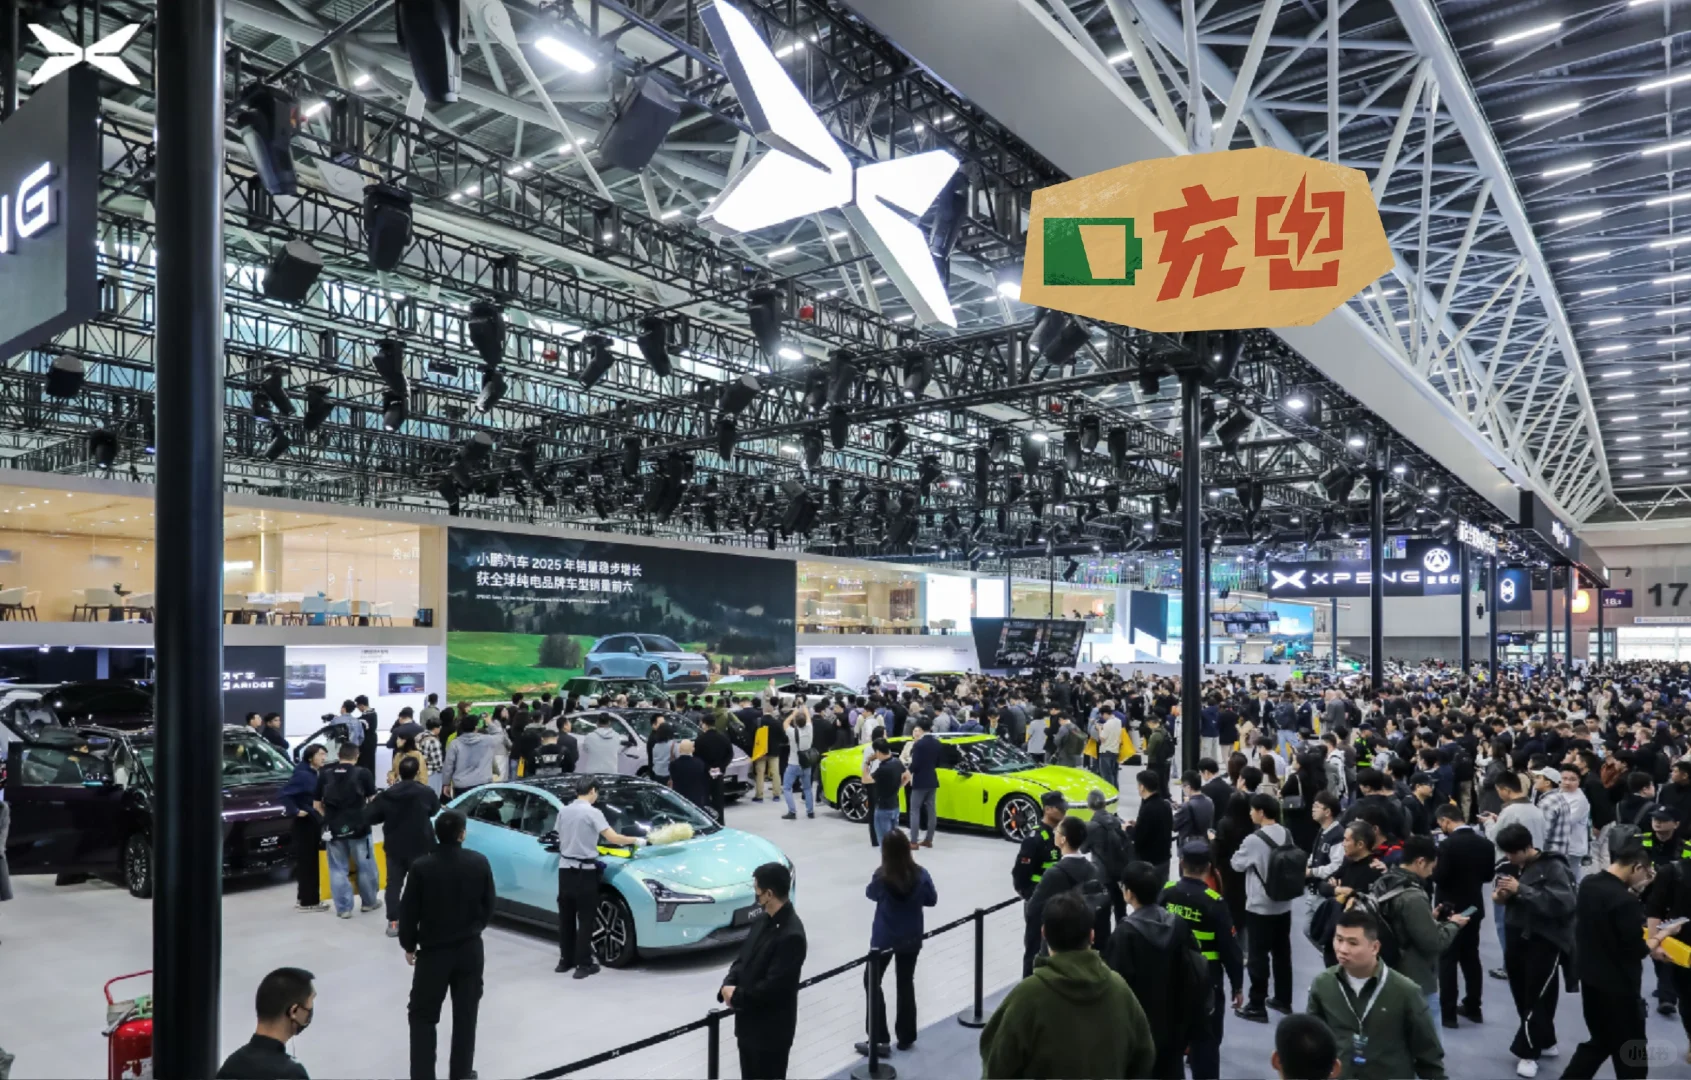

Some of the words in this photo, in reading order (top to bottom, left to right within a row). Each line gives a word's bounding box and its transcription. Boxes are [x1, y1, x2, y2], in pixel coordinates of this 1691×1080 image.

[476, 552, 529, 569] 小鹏汽车
[532, 558, 562, 571] 2025
[564, 558, 642, 577] 年销量稳步增长
[476, 571, 633, 593] 获全球纯电品牌车型销量前六
[1312, 571, 1420, 584] XPENG
